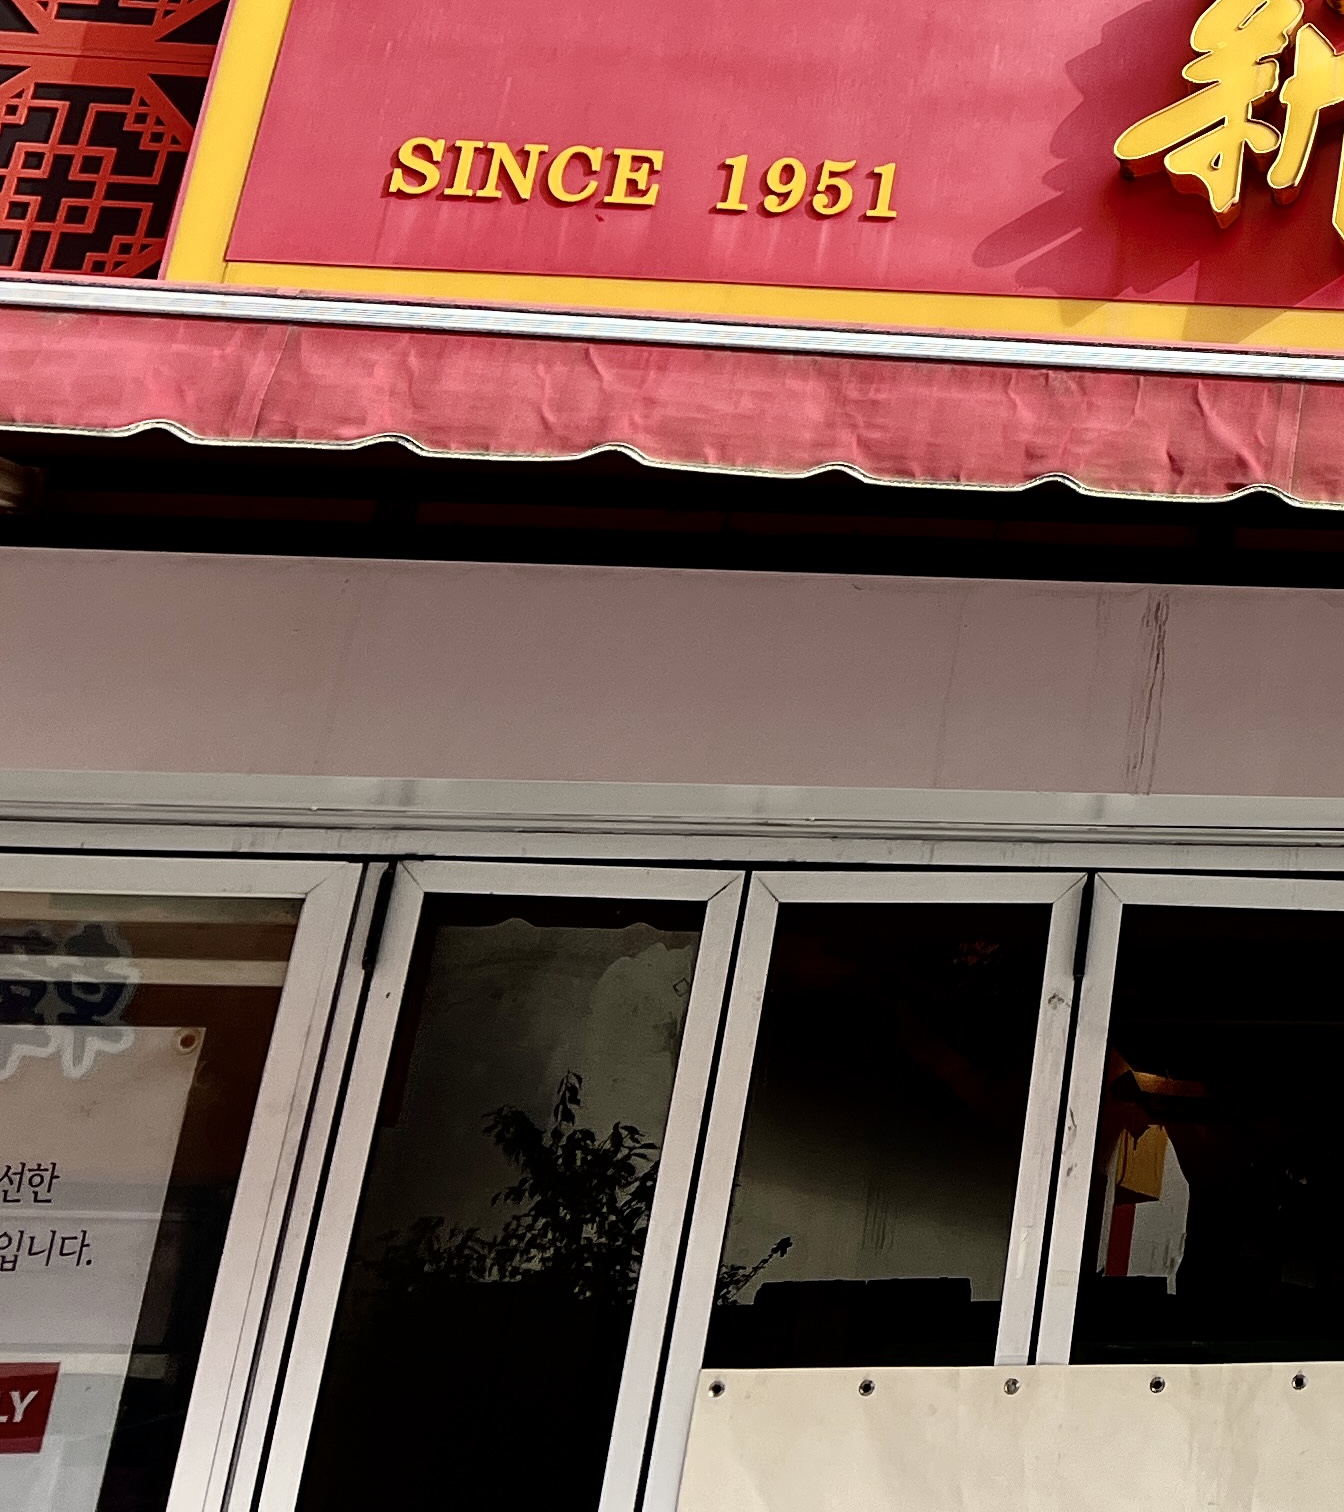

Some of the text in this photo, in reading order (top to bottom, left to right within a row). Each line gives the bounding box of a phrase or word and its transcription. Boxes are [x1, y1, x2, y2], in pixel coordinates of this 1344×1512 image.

[388, 136, 898, 219] SINCE 1951
[0, 1229, 93, 1272] 입니다.
